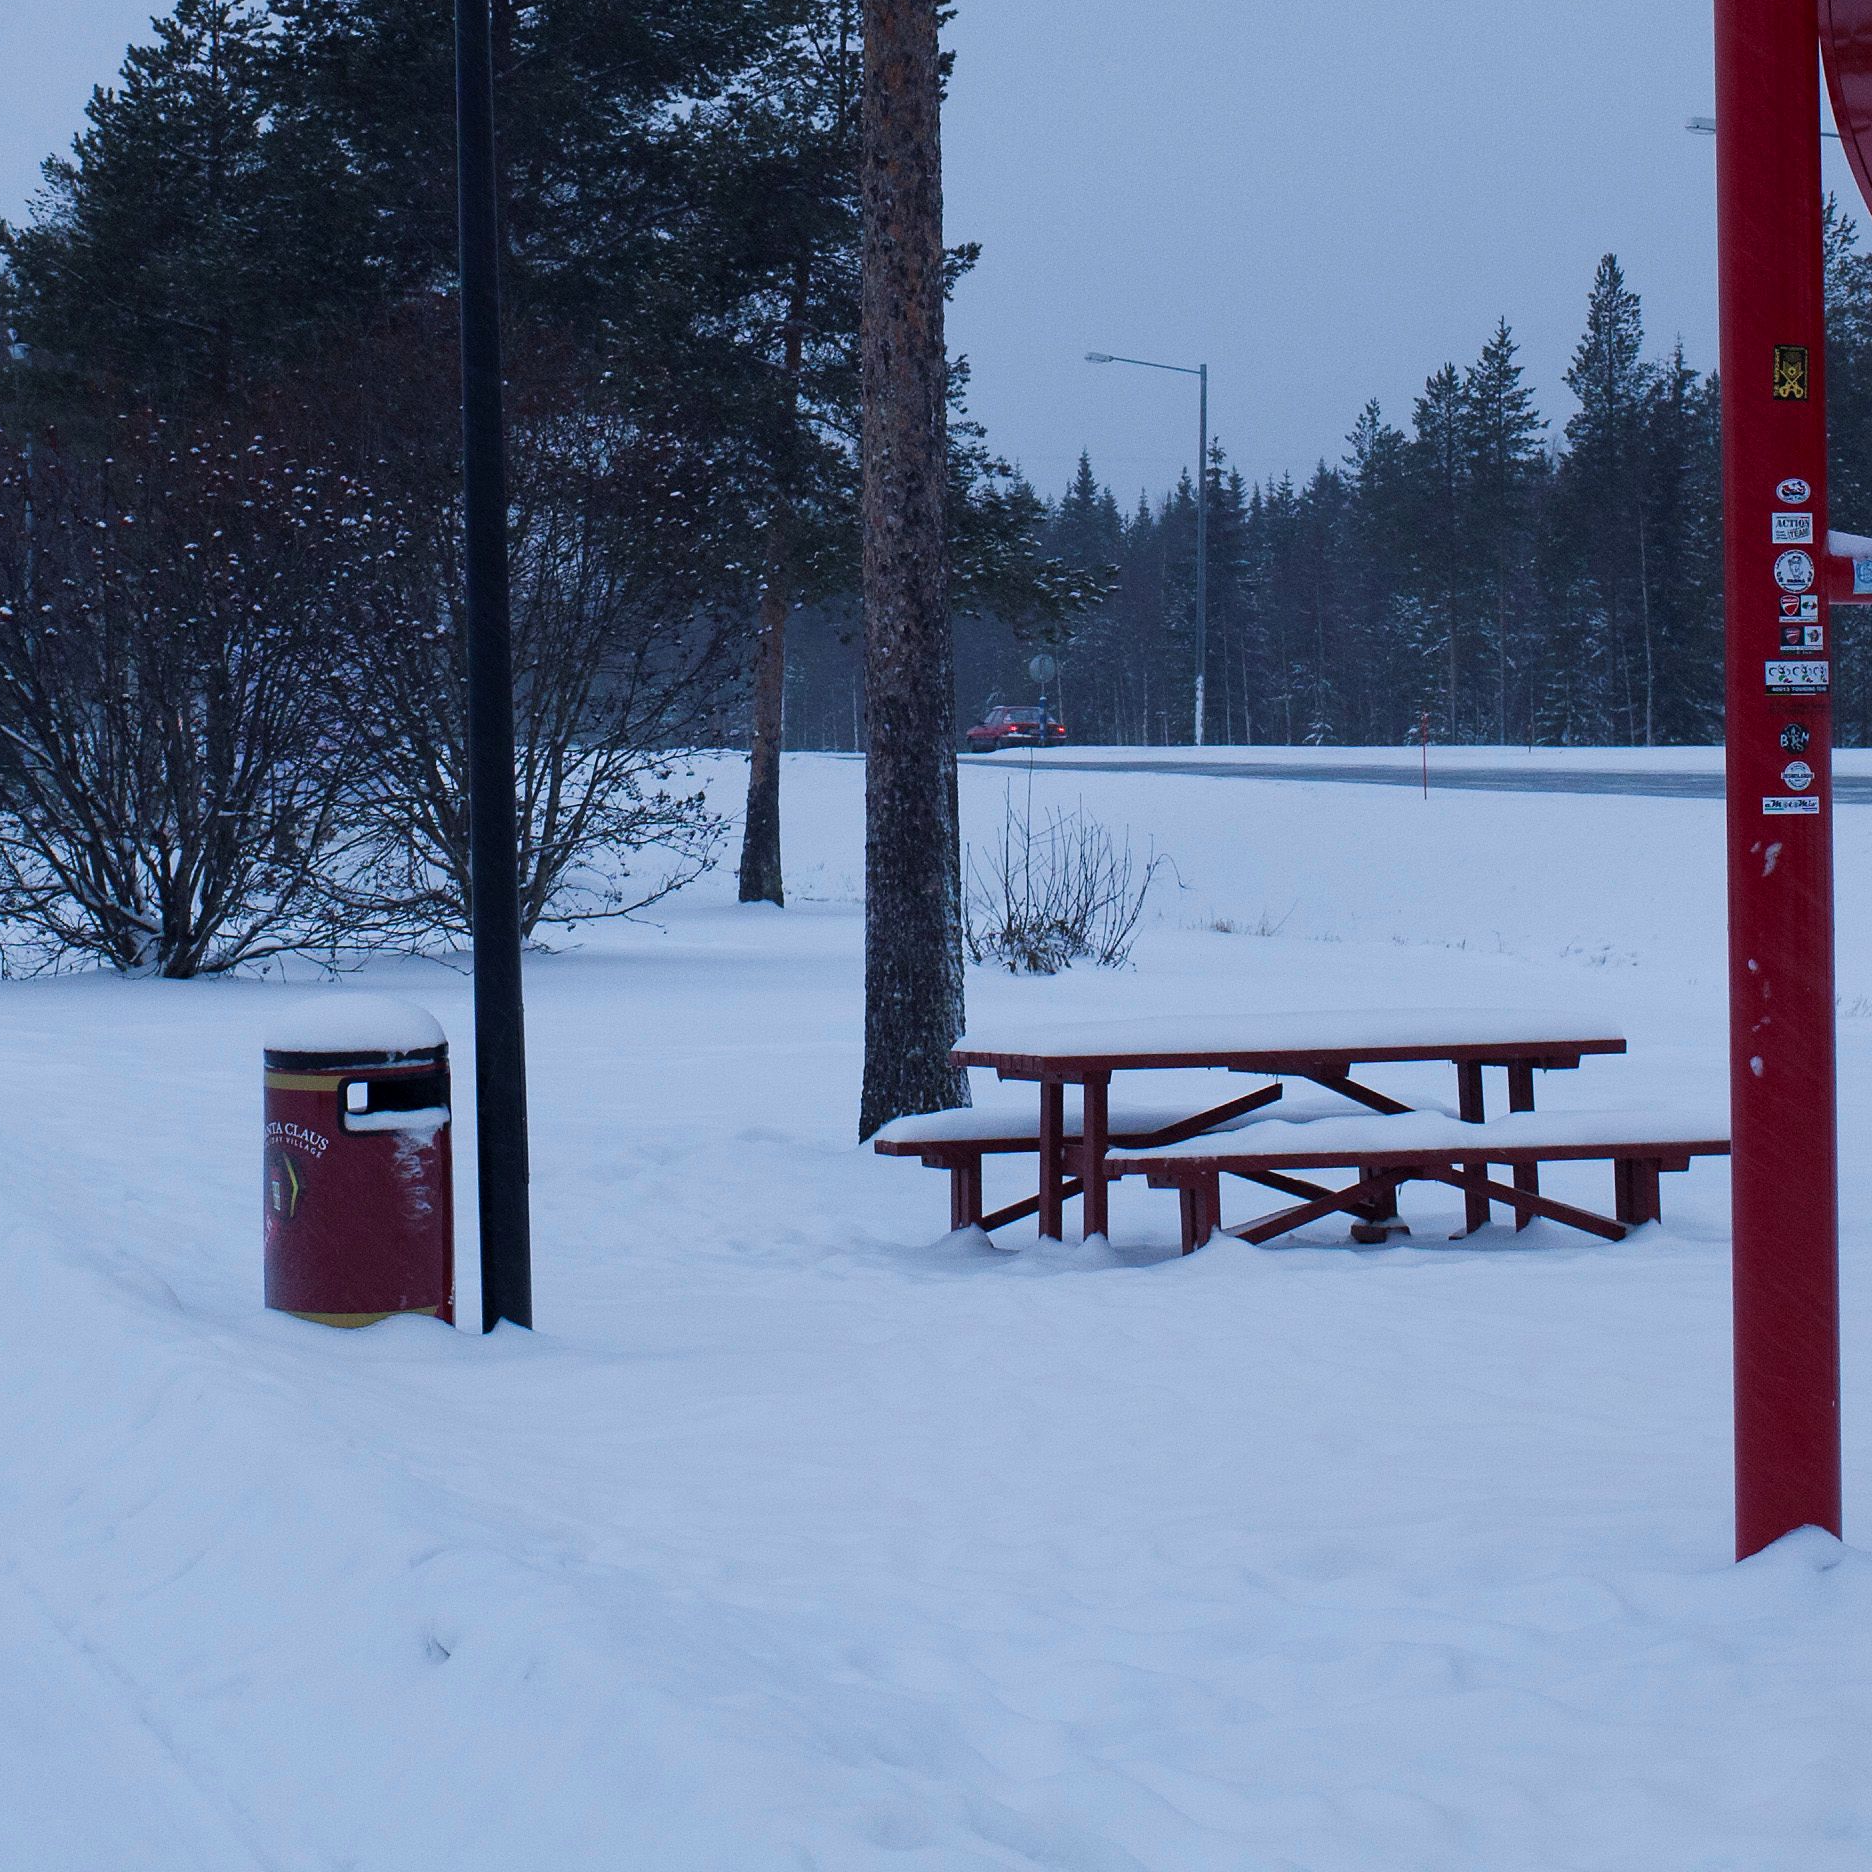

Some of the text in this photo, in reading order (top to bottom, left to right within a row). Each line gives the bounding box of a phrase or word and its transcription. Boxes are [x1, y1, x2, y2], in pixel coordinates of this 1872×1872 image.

[1776, 519, 1810, 528] ACTION
[285, 1122, 329, 1151] CLAUS
[286, 1137, 322, 1159] VILLAGE
